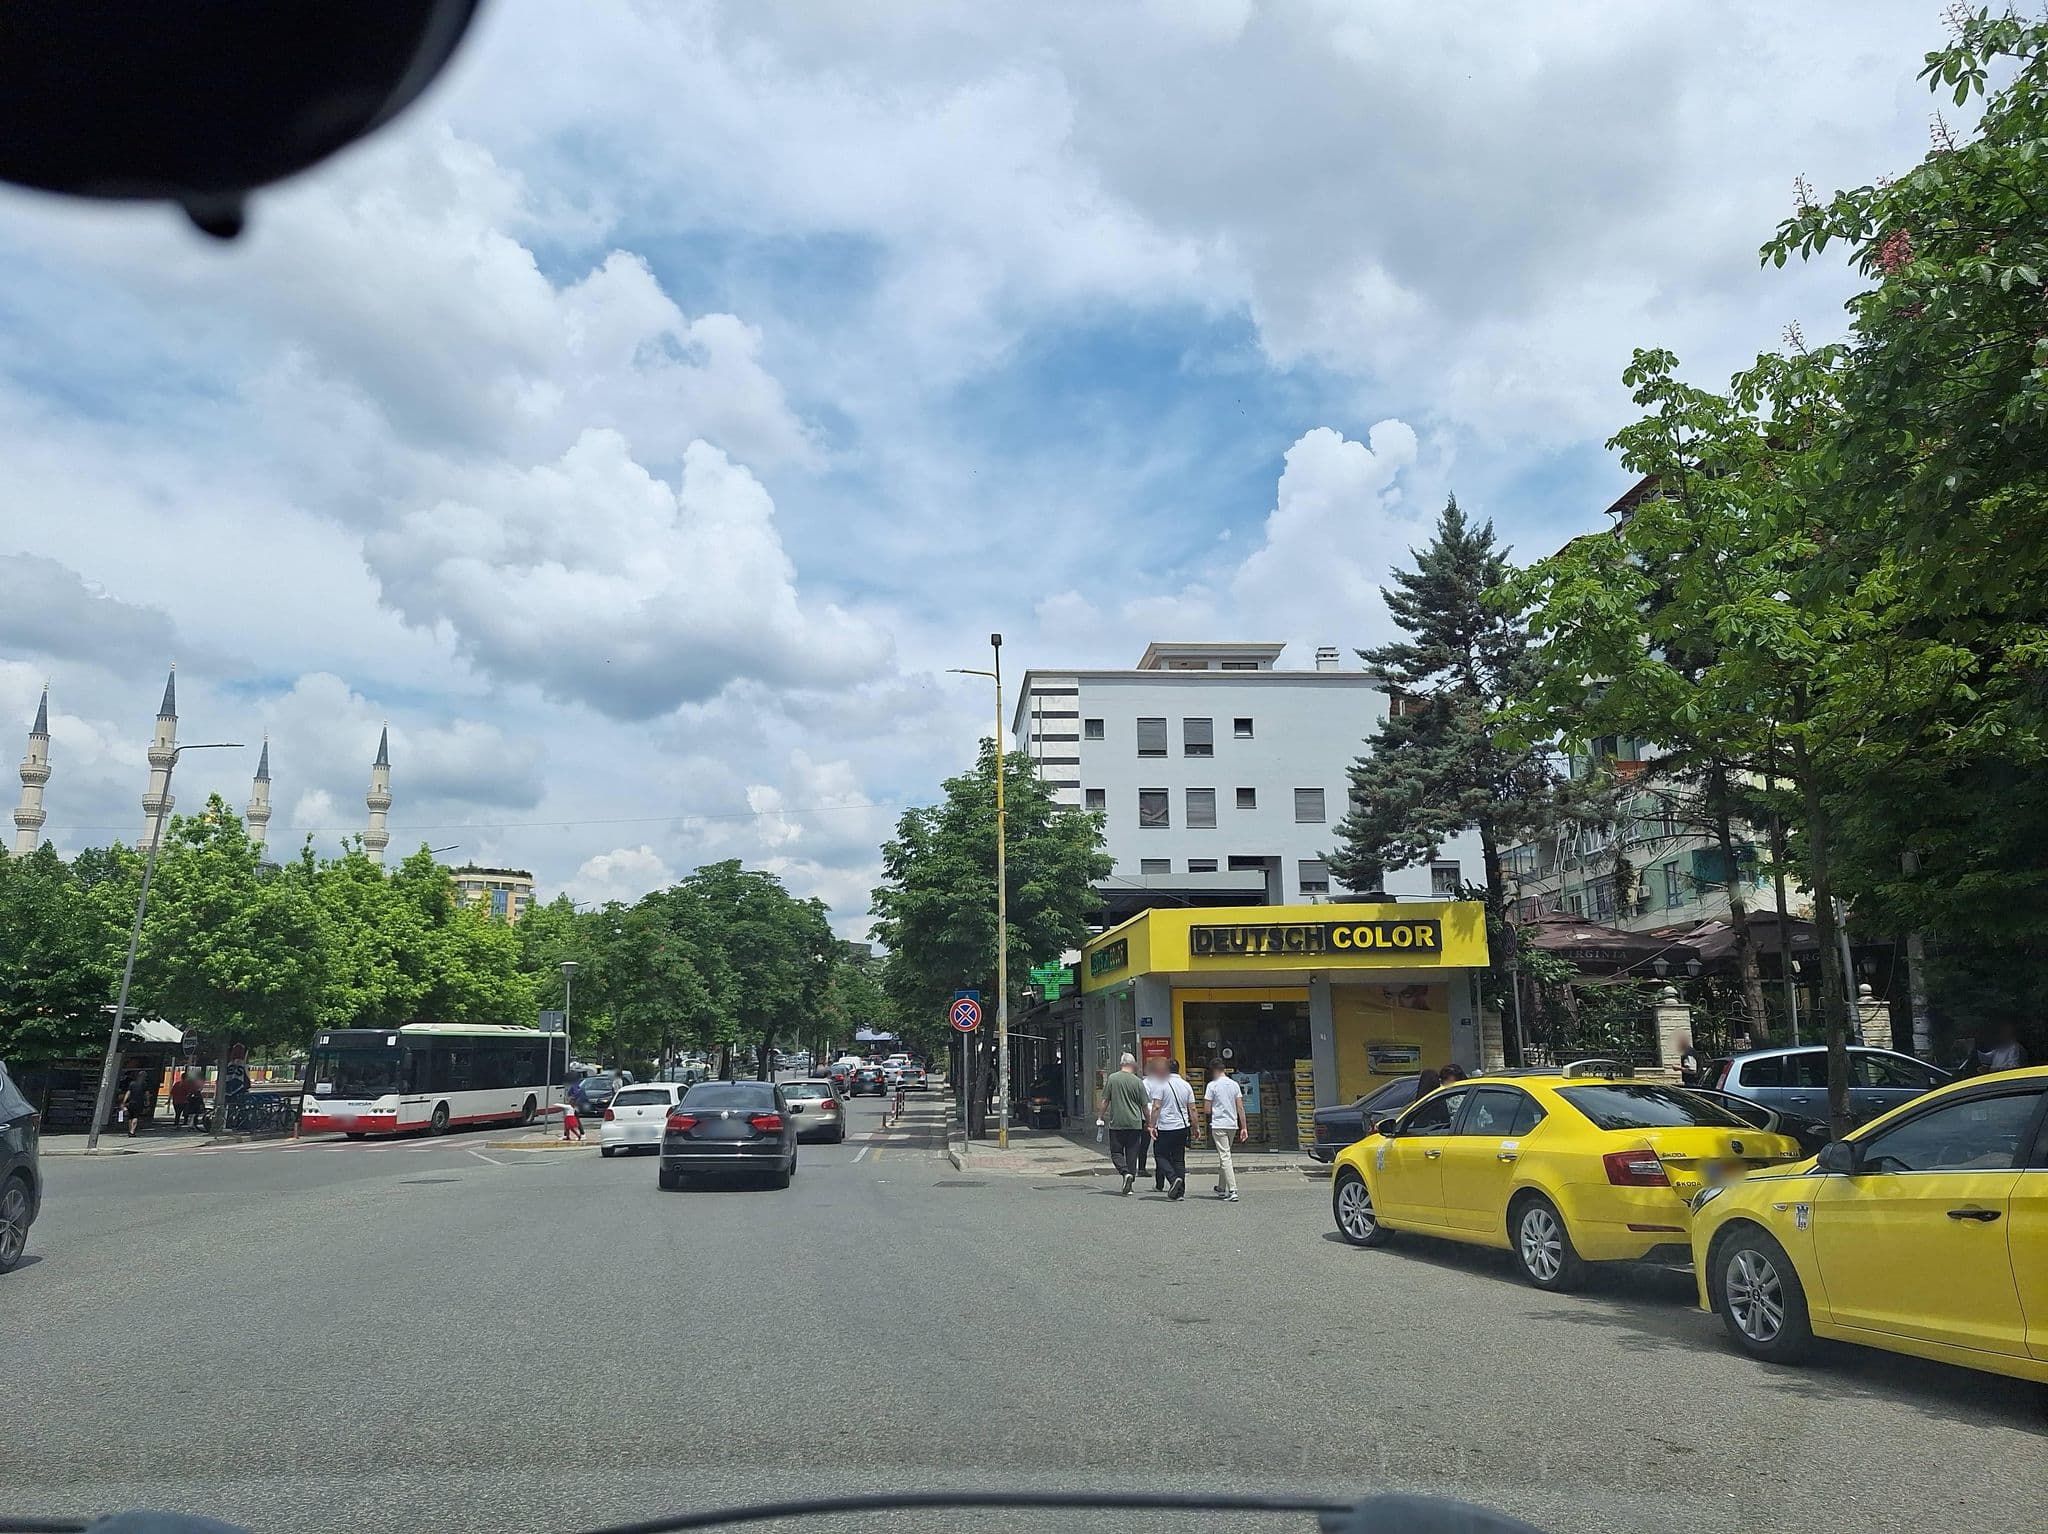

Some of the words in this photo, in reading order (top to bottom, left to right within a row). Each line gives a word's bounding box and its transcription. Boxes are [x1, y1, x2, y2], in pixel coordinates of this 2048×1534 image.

[1195, 927, 1323, 952] DEUTSCH
[1333, 926, 1435, 948] COLOR
[1581, 1064, 1623, 1072] TAXI
